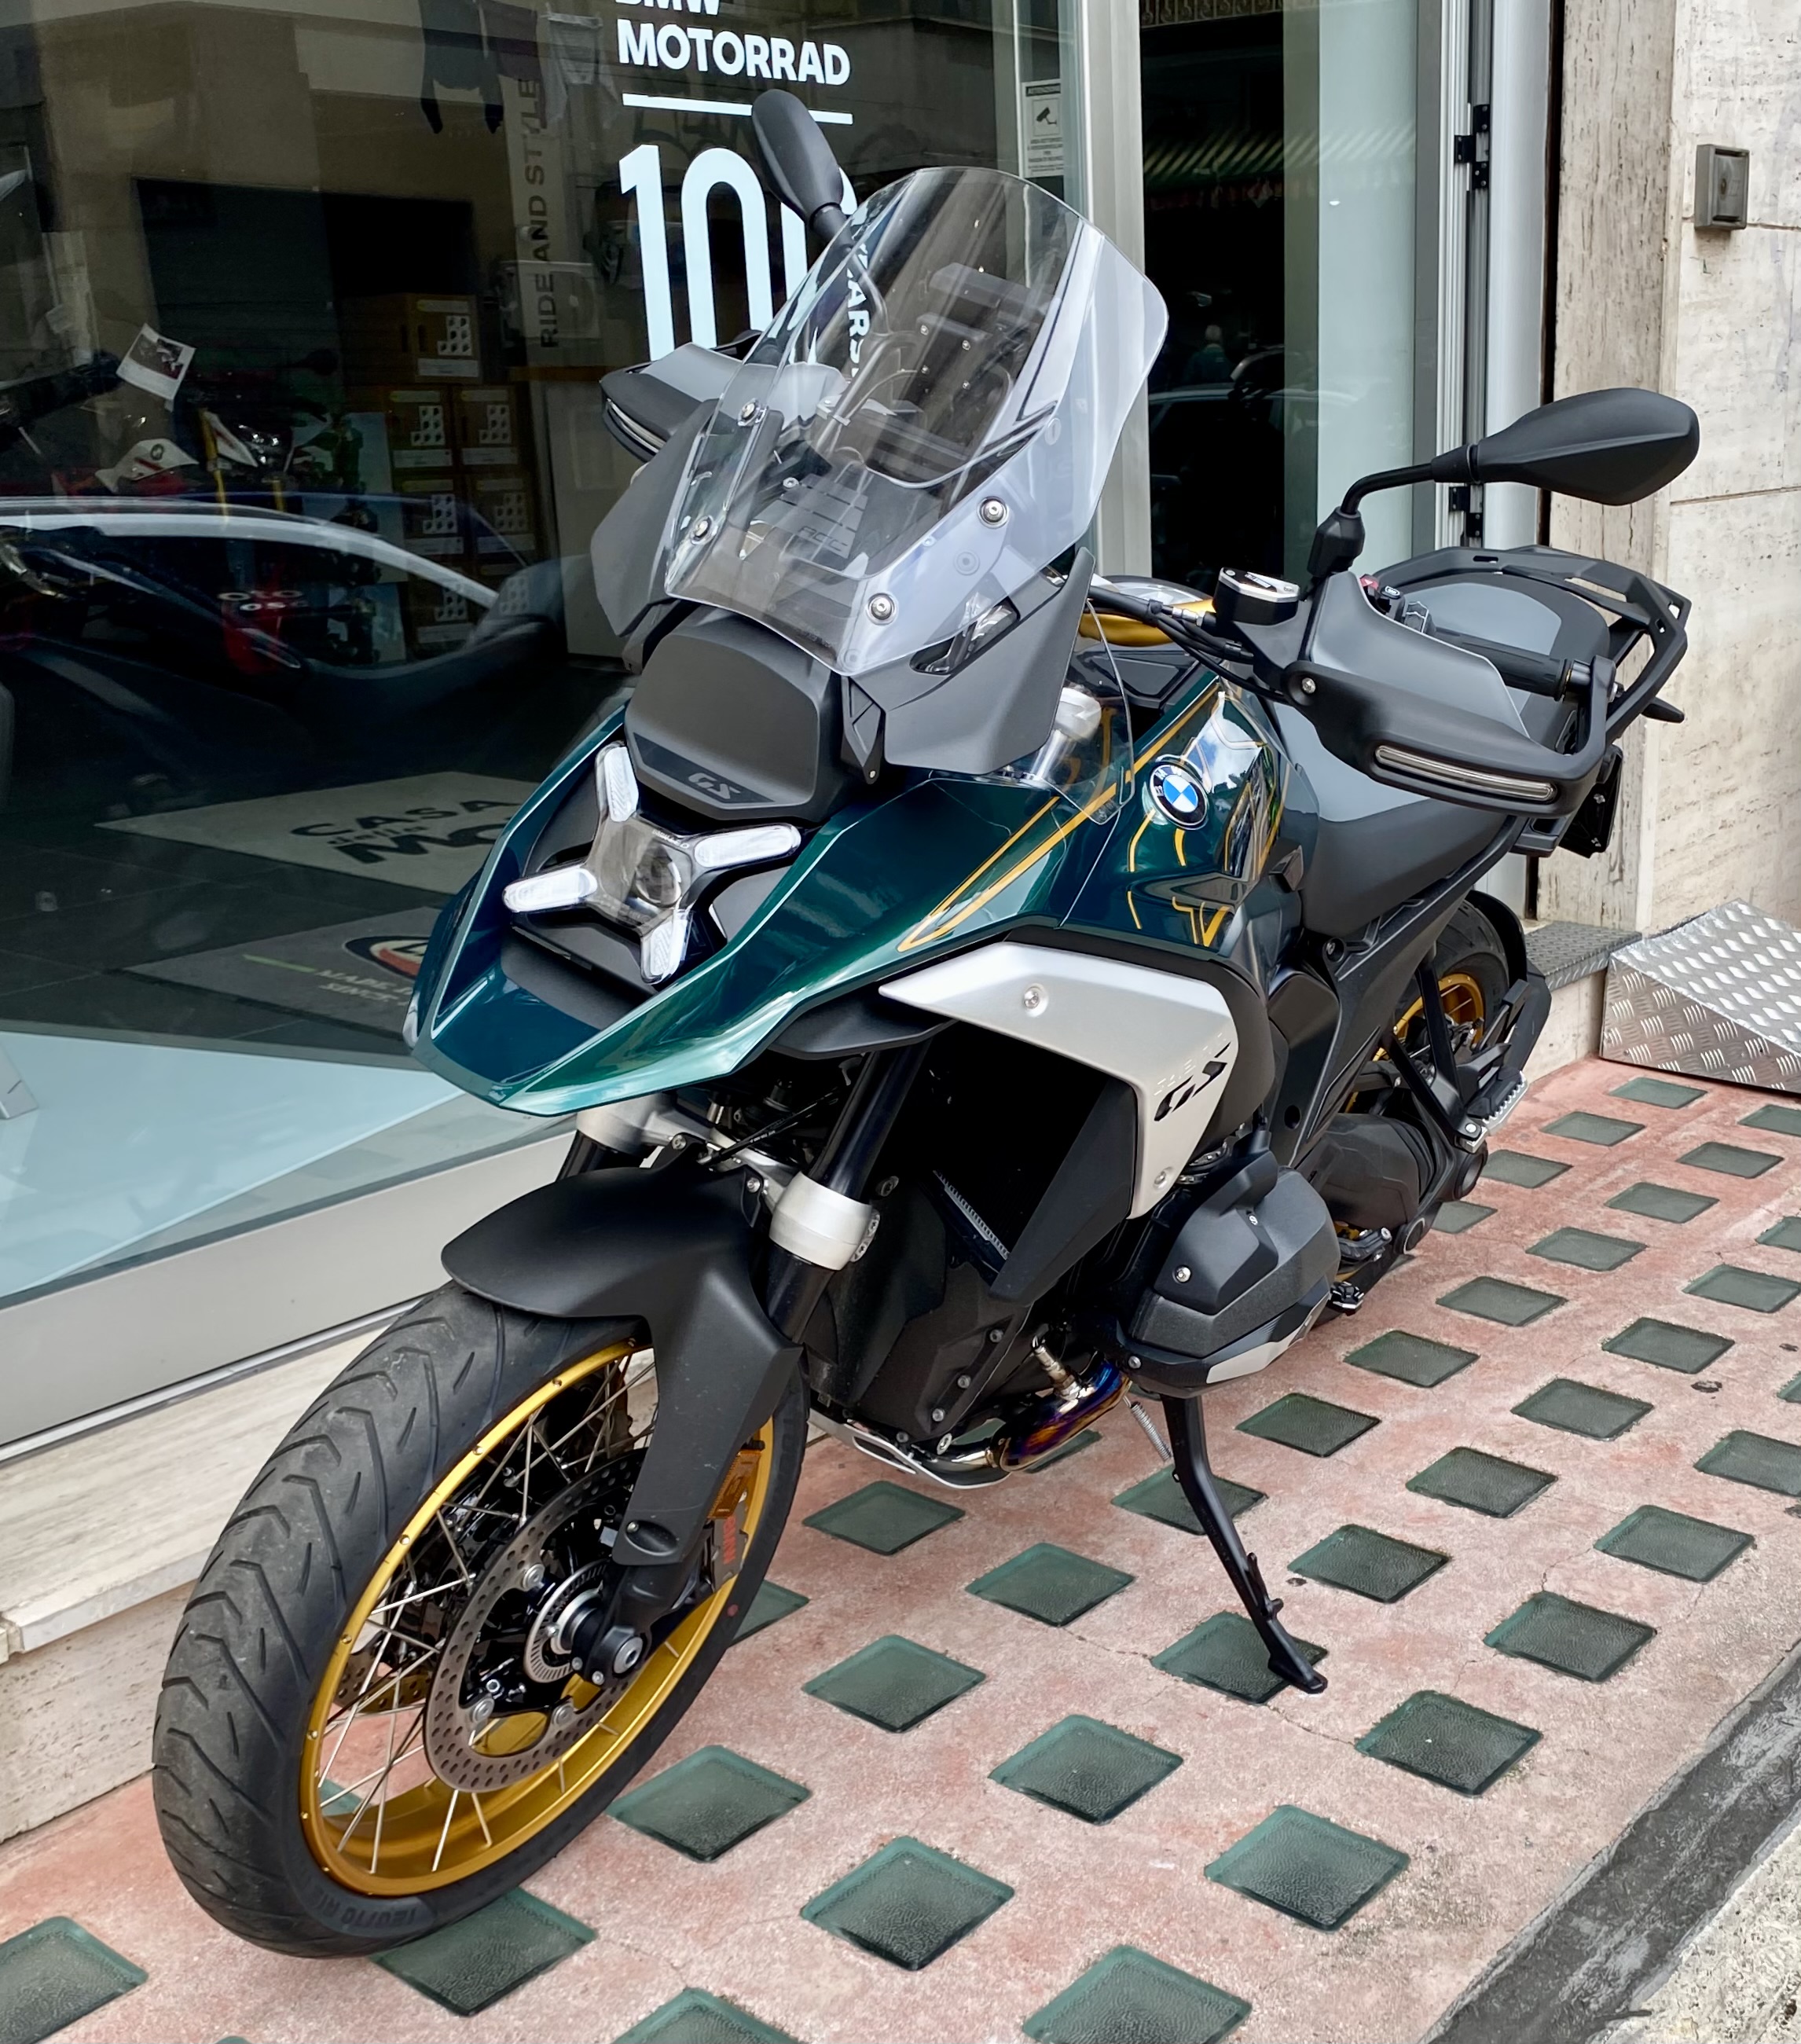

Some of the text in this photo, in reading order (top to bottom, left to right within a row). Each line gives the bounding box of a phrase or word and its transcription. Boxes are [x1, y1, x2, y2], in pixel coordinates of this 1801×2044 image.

[617, 18, 851, 86] MOTORRAD
[519, 79, 559, 348] RIDE AND STYLE
[798, 525, 849, 552] ACC
[688, 772, 740, 799] GS
[290, 800, 522, 837] CASA
[334, 817, 509, 864] MO
[1154, 1041, 1231, 1122] GS
